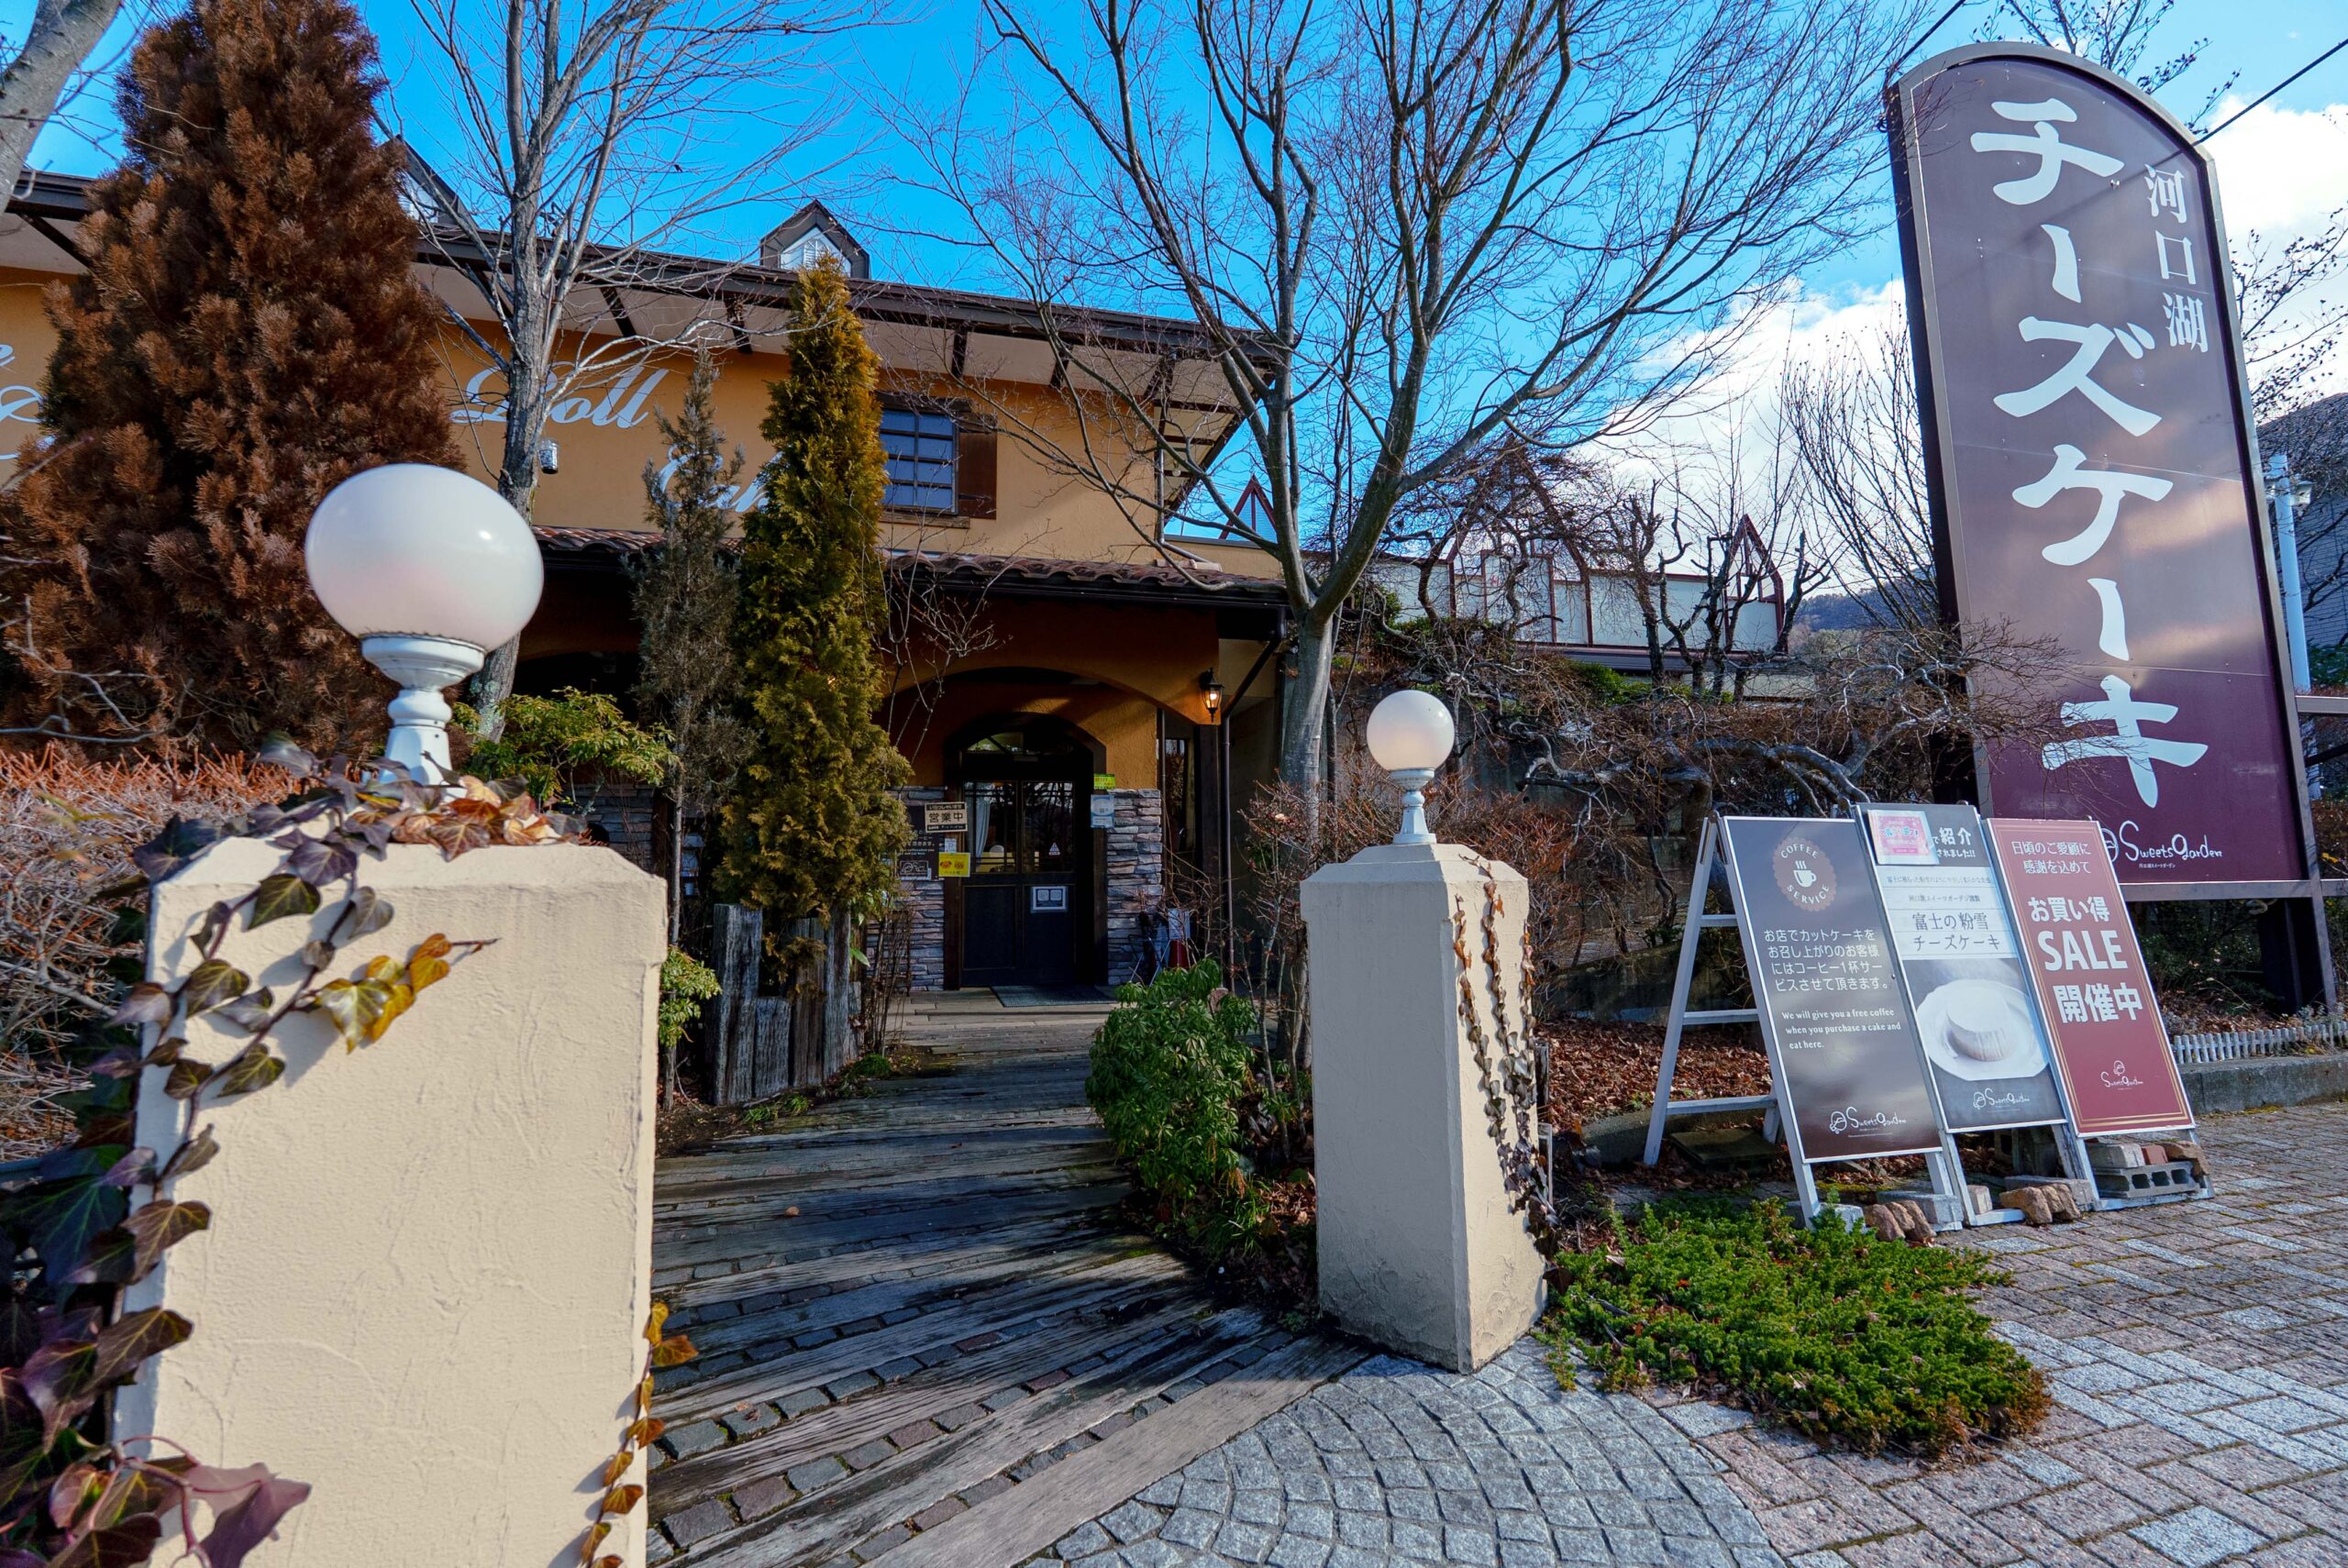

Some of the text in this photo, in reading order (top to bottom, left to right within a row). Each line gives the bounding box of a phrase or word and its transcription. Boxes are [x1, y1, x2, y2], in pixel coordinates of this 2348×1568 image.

[2144, 162, 2209, 353] 河口湖
[1971, 97, 2208, 808] チーズケーキ
[928, 812, 963, 823] 営業中
[1780, 843, 1820, 858] COFFEE
[2011, 841, 2091, 856] 日頃のご愛顧に
[2022, 860, 2092, 874] 感謝を込めて
[1787, 884, 1830, 904] SERVICE
[2028, 896, 2110, 922] お買い得
[1912, 912, 1988, 931] 富士の粉雪
[1764, 929, 1876, 943] お店でカットケーキを
[1913, 934, 2000, 952] チーズケーキ
[1768, 944, 1880, 959] お召し上がりのお客様
[2037, 930, 2128, 971] SALE
[1771, 961, 1883, 975] にはコーヒー1杯サー
[1776, 977, 1888, 992] ビスさせて頂きます。
[2053, 982, 2143, 1023] 開催中
[1781, 1011, 1795, 1020] We
[1796, 1010, 1811, 1020] will
[1812, 1010, 1828, 1021] give
[1830, 1011, 1845, 1021] you
[1852, 1009, 1869, 1018] free
[1869, 1008, 1895, 1017] coffee
[1786, 1025, 1807, 1034] when
[1809, 1026, 1823, 1035] you
[1824, 1023, 1860, 1034] purchase
[1867, 1022, 1887, 1032] cake
[1888, 1022, 1901, 1031] and
[1789, 1040, 1825, 1050] eat here.
